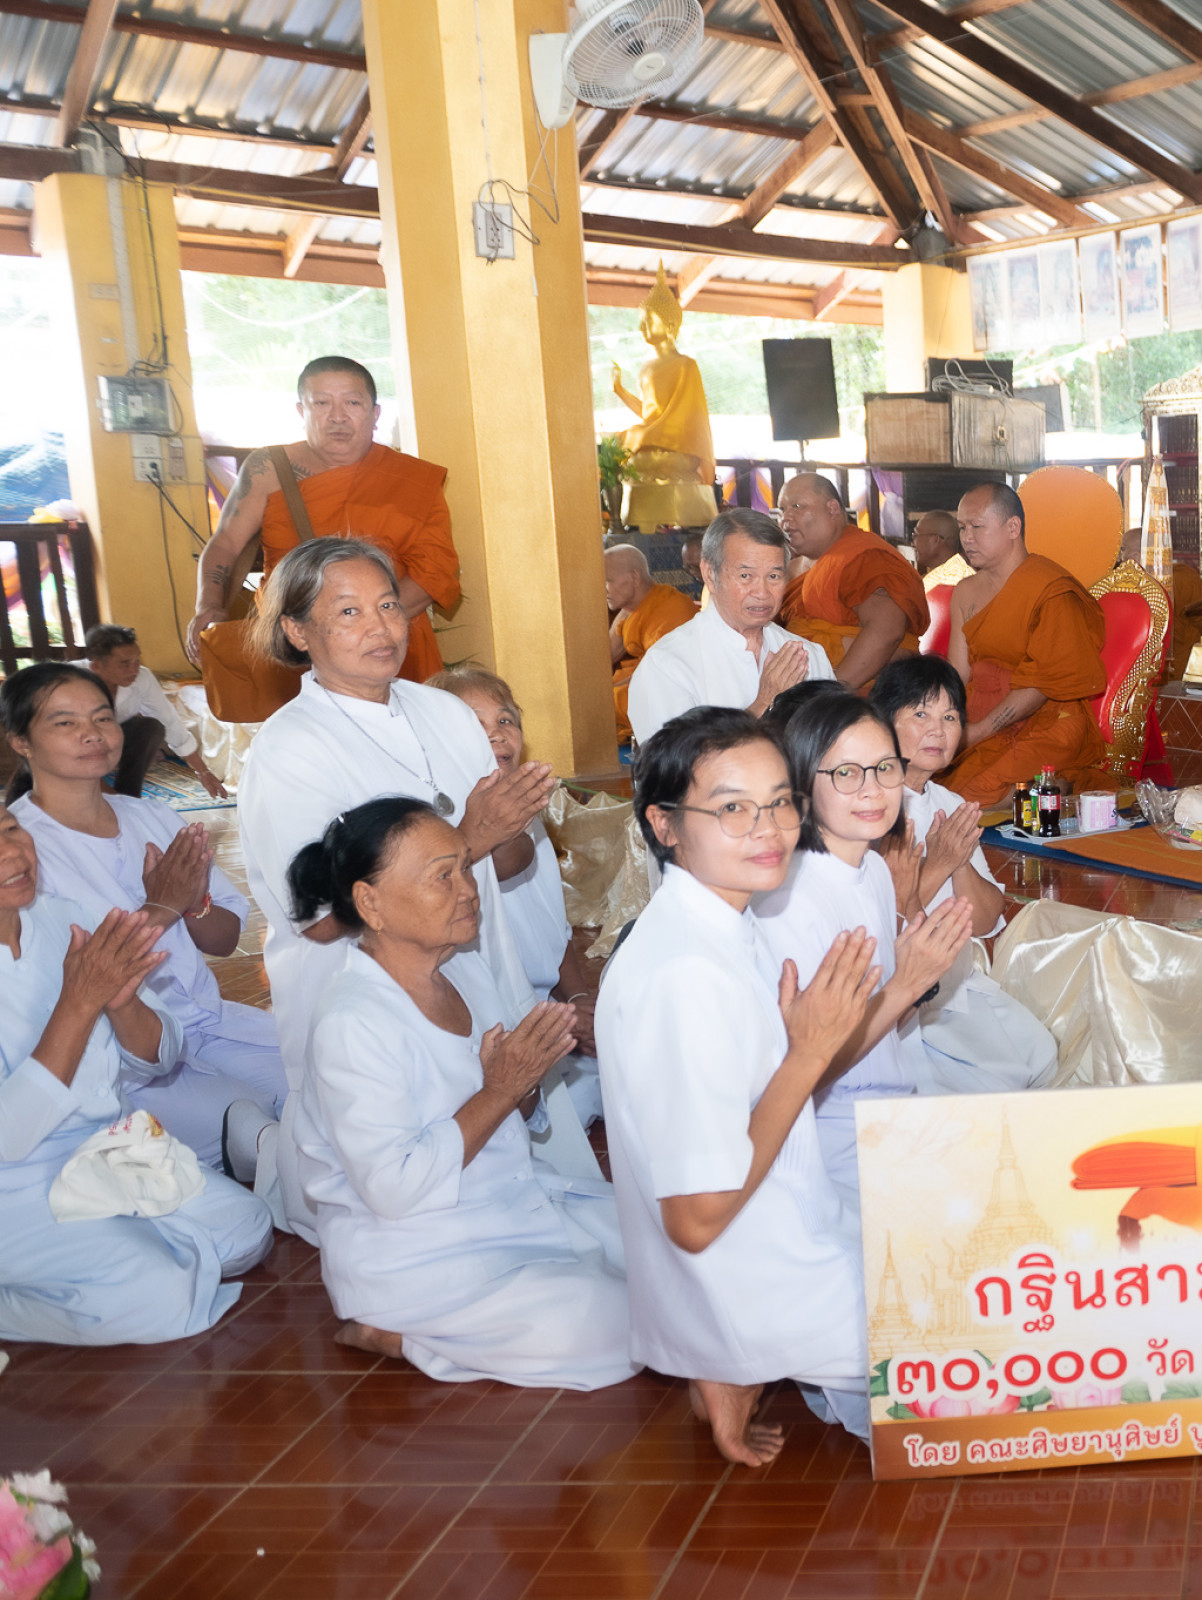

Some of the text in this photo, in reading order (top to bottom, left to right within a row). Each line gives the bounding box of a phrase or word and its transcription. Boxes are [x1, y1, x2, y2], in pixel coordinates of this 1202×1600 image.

[896, 1347, 1128, 1399] ๓๐,๐๐๐
[1146, 1338, 1195, 1376] วัด
[907, 1437, 957, 1464] โดย
[970, 1417, 1179, 1459] คณะศิษยานุศิษย์
